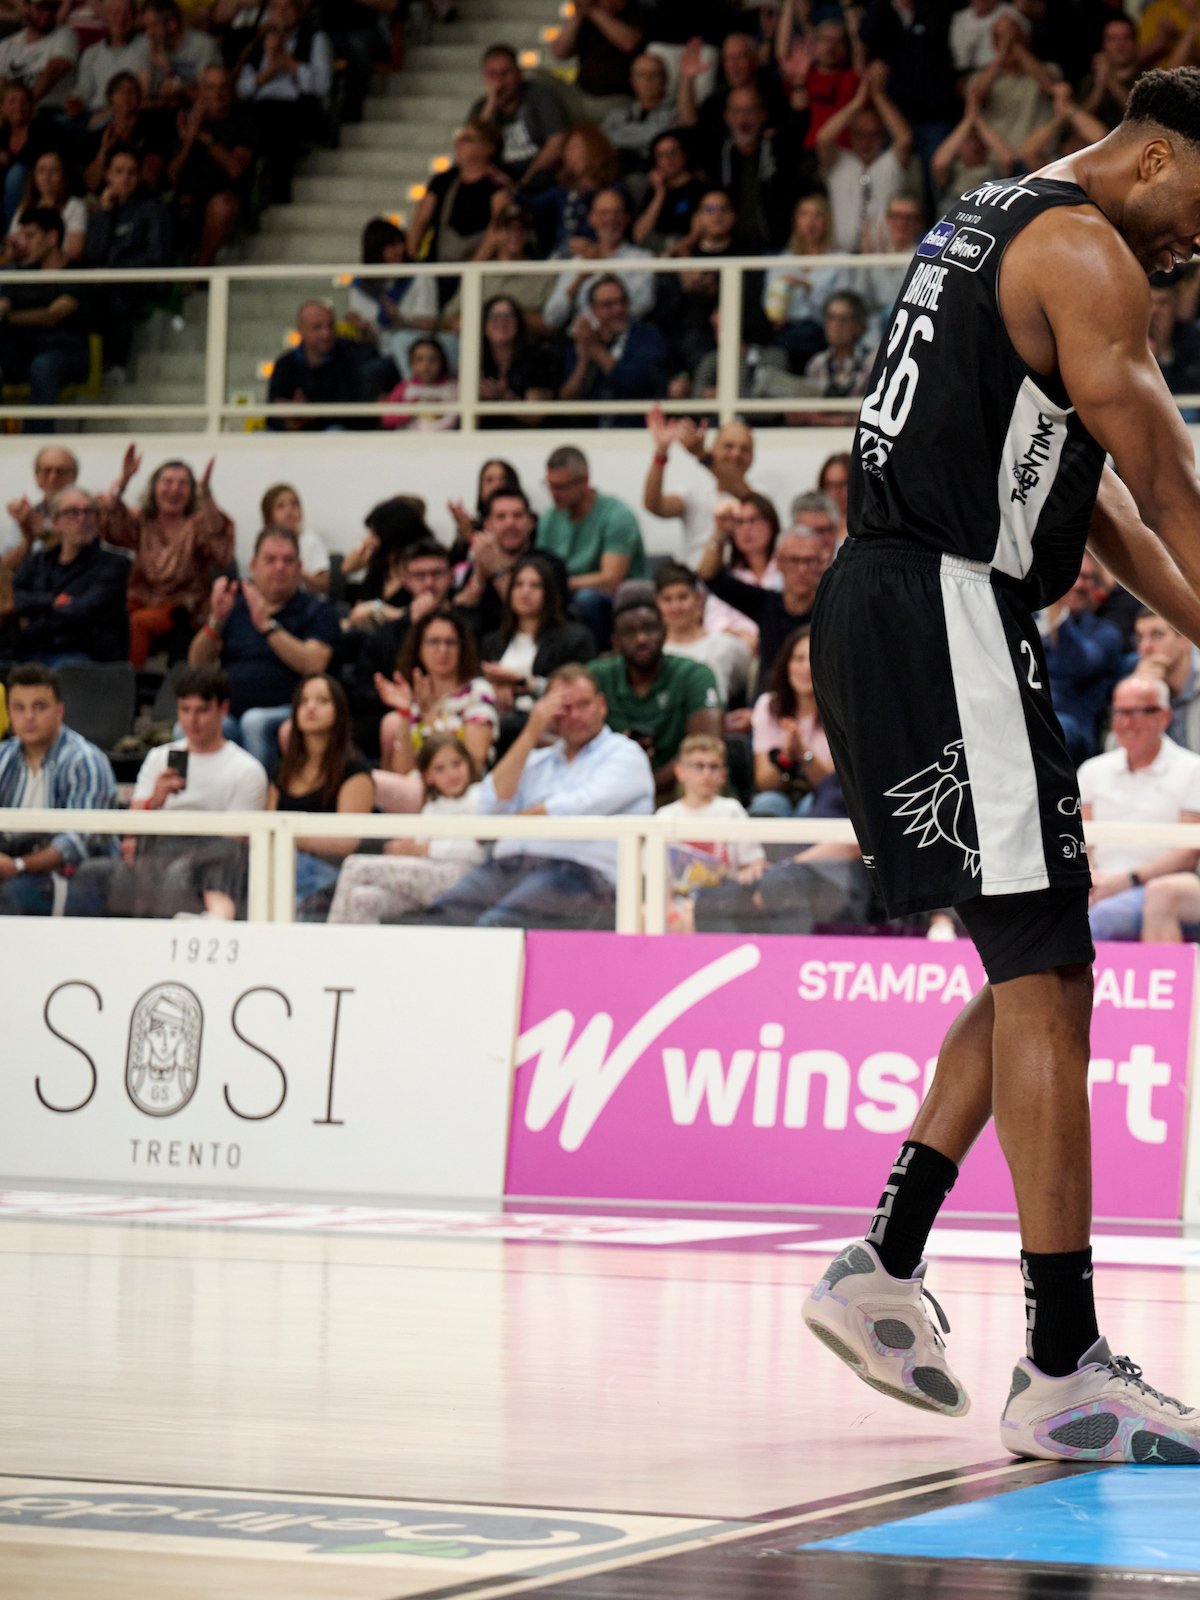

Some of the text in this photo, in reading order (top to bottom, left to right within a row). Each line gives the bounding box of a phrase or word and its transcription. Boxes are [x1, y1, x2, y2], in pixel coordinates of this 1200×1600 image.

[955, 212, 982, 224] TRENTO
[170, 938, 241, 964] 1923
[798, 960, 974, 1004] STAMPA
[130, 1139, 241, 1169] TRENTO
